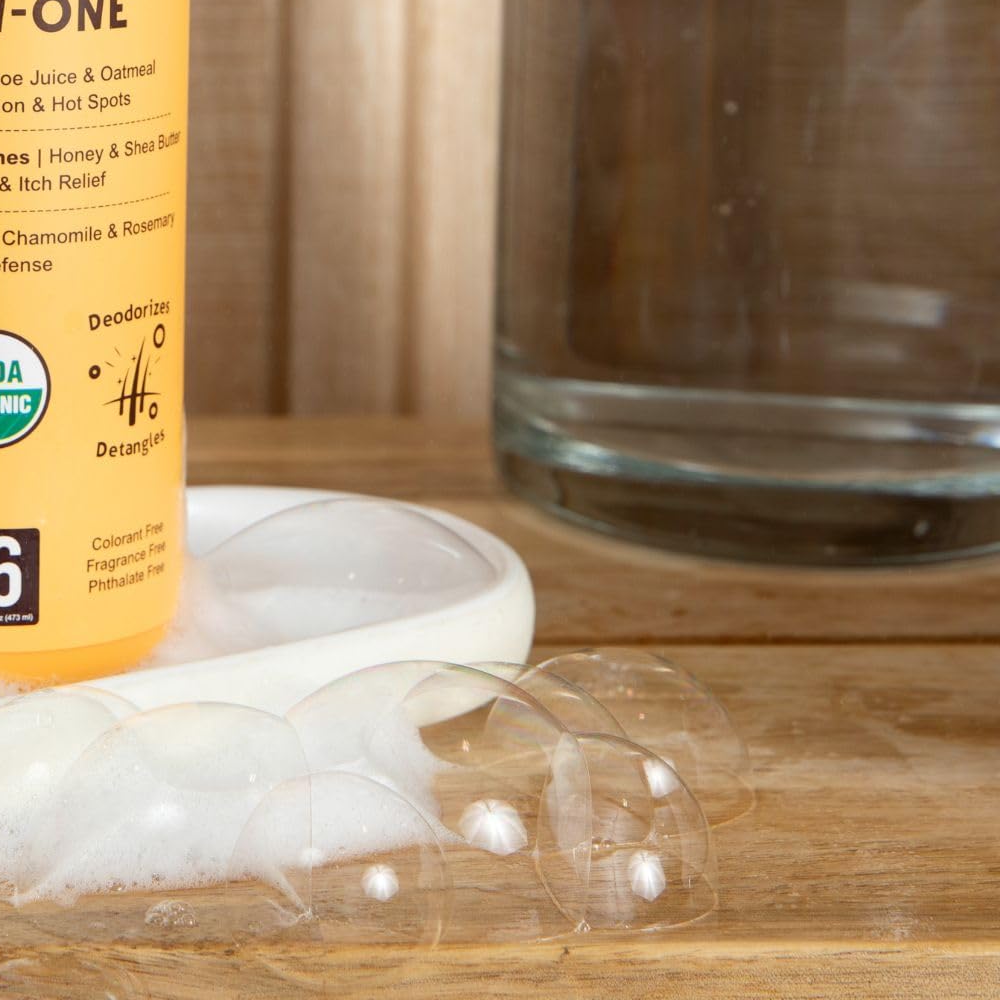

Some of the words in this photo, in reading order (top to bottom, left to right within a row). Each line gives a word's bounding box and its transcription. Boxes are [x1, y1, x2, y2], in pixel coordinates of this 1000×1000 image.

[30, 69, 77, 86] Juice
[83, 67, 94, 83] &
[100, 59, 156, 81] Oatmeal
[32, 96, 45, 112] &
[52, 96, 82, 112] Hot
[88, 92, 131, 112] Spots
[50, 147, 104, 165] Honey
[109, 143, 119, 159] &
[124, 140, 155, 156] Shea
[158, 131, 181, 150] Butter
[19, 176, 51, 191] Itch
[59, 171, 106, 190] Relief
[2, 226, 102, 246] Chamomile
[107, 223, 117, 239] &
[123, 212, 175, 236] Rosemary
[89, 299, 170, 331] Deodorizes
[96, 428, 165, 458] Detangles
[92, 528, 142, 551] Colorant
[145, 522, 163, 537] Free
[87, 550, 146, 572] Fragrance
[149, 541, 166, 557] Free
[89, 571, 144, 593] Phthalate
[147, 562, 165, 579] Free
